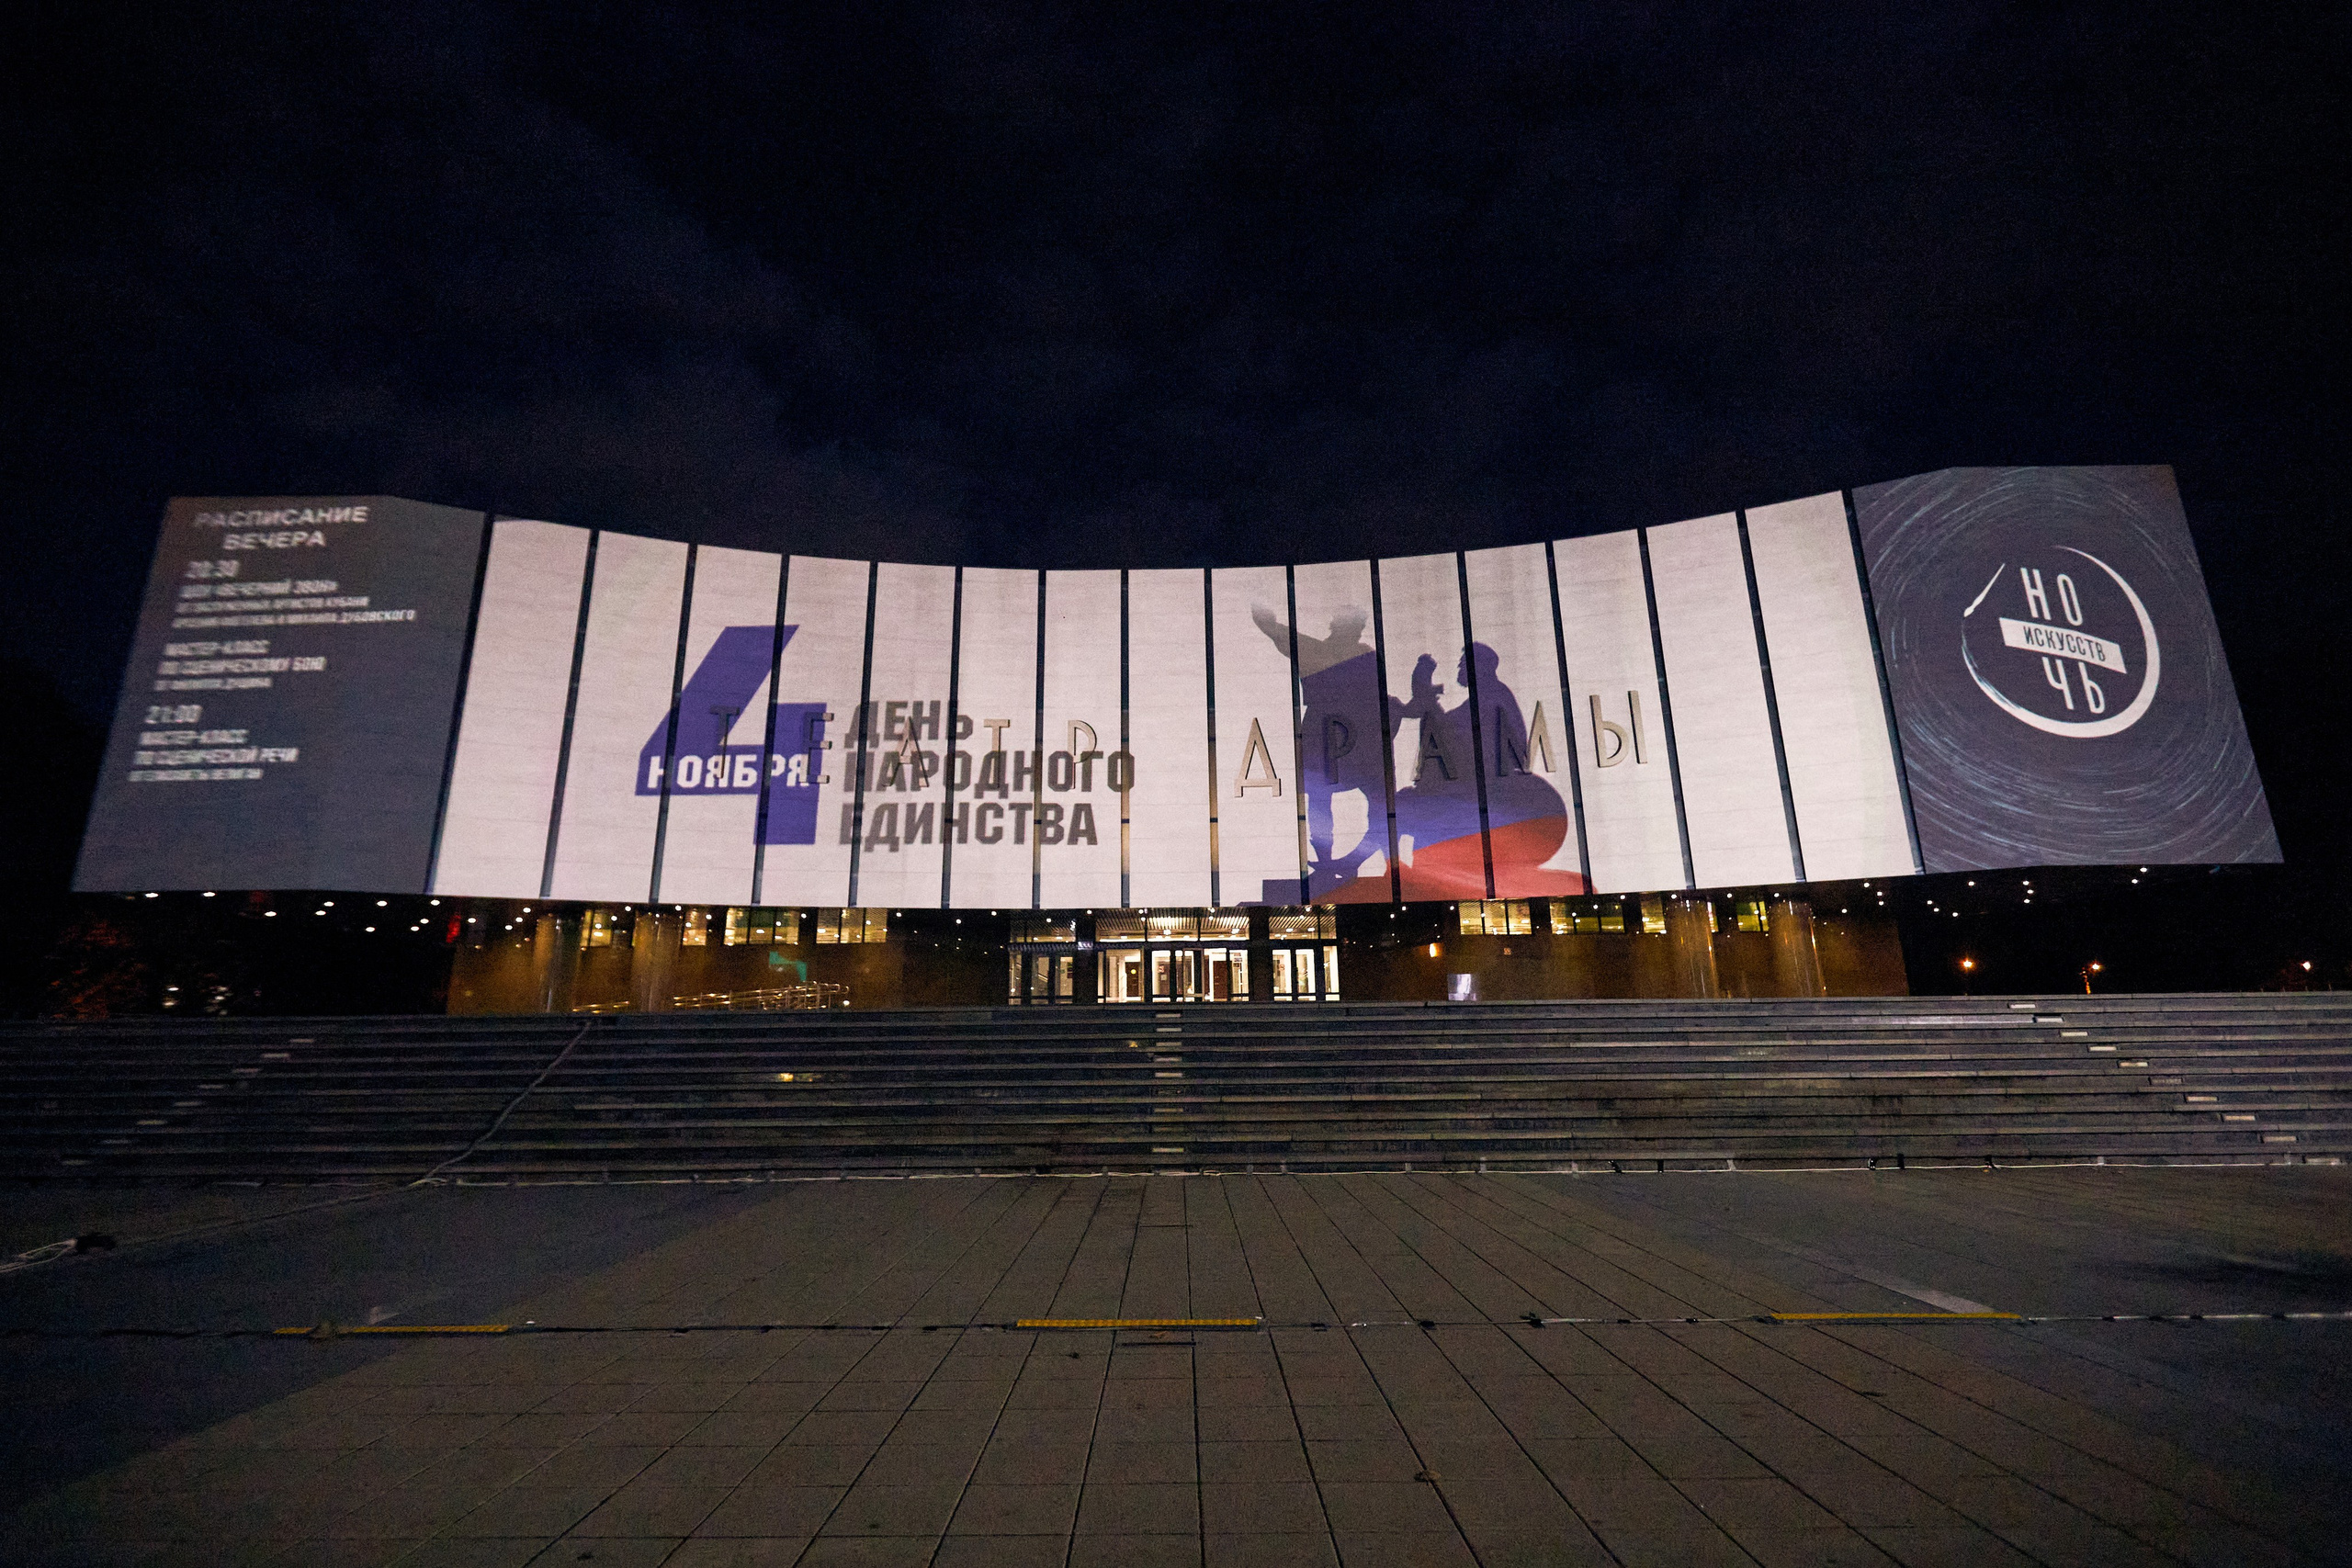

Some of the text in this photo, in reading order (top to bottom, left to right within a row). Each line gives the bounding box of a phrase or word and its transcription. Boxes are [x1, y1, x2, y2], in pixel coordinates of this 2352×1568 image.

[194, 506, 370, 529] РАСПИСАНИЕ
[223, 531, 327, 551] ВЕЧЕРА
[2023, 625, 2107, 662] ИСКУССТВ
[635, 624, 828, 846] 4
[708, 689, 1649, 798] ТЕАТР ДРАМЫ
[843, 699, 974, 750] ДЕНЬ
[647, 751, 810, 789] НОЯБРЯ
[842, 750, 1136, 799] НАРОДНОГО
[839, 801, 1099, 852] ЕДИНСТВА
